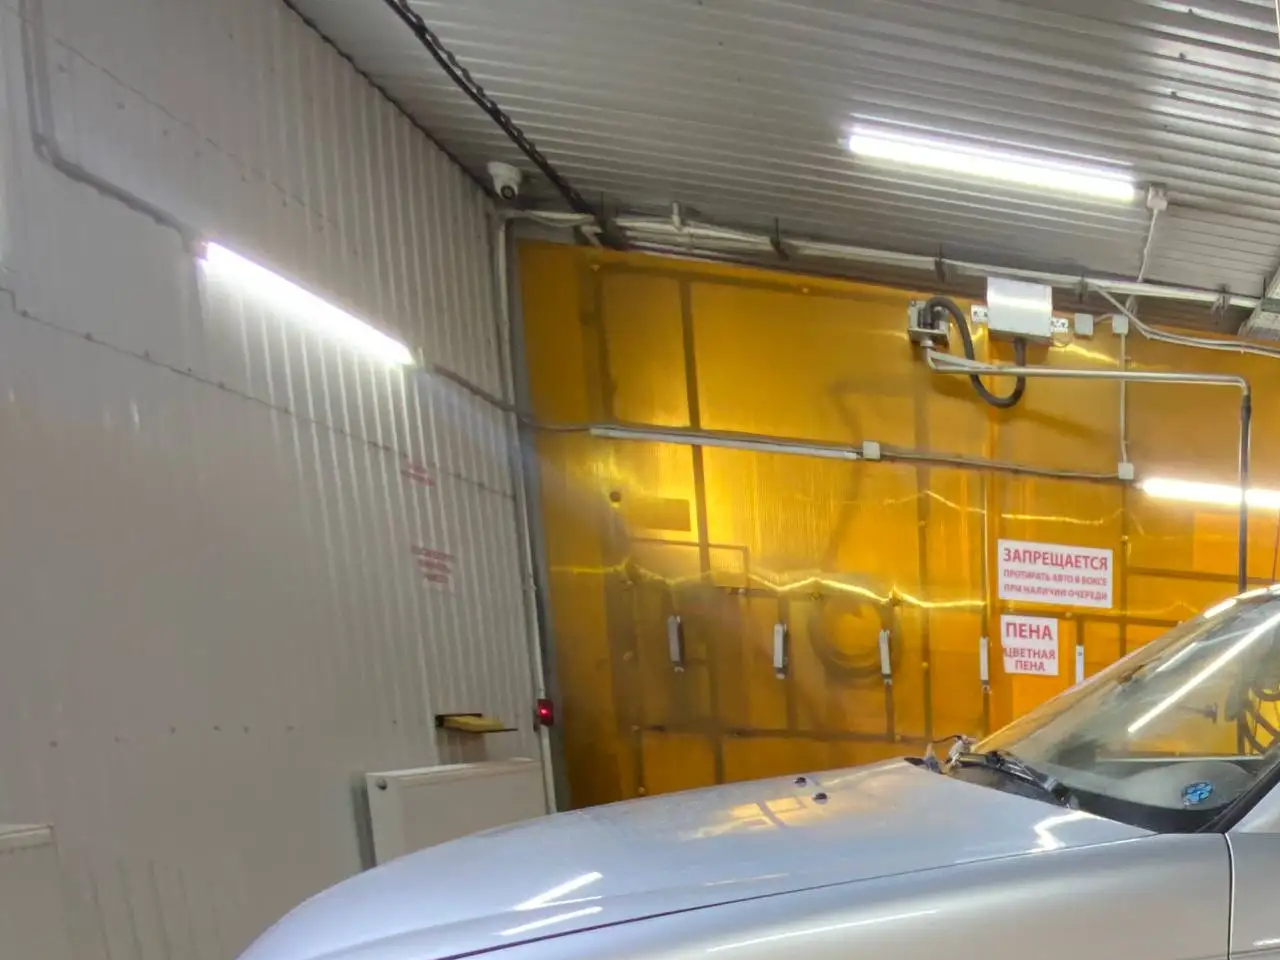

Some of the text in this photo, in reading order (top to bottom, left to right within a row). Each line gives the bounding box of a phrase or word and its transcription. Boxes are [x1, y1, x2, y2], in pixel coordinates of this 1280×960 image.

[1003, 548, 1108, 571] ЗАПРЕЩАЕТСЯ
[1053, 574, 1073, 583] АВТО
[1004, 583, 1022, 593] ПРИ
[1068, 589, 1107, 600] ОЧЕРЕДИ
[1006, 622, 1053, 641] ПЕНА
[1004, 647, 1056, 659] ЦВЕТНАЯ
[1015, 660, 1045, 671] ПЕНА
